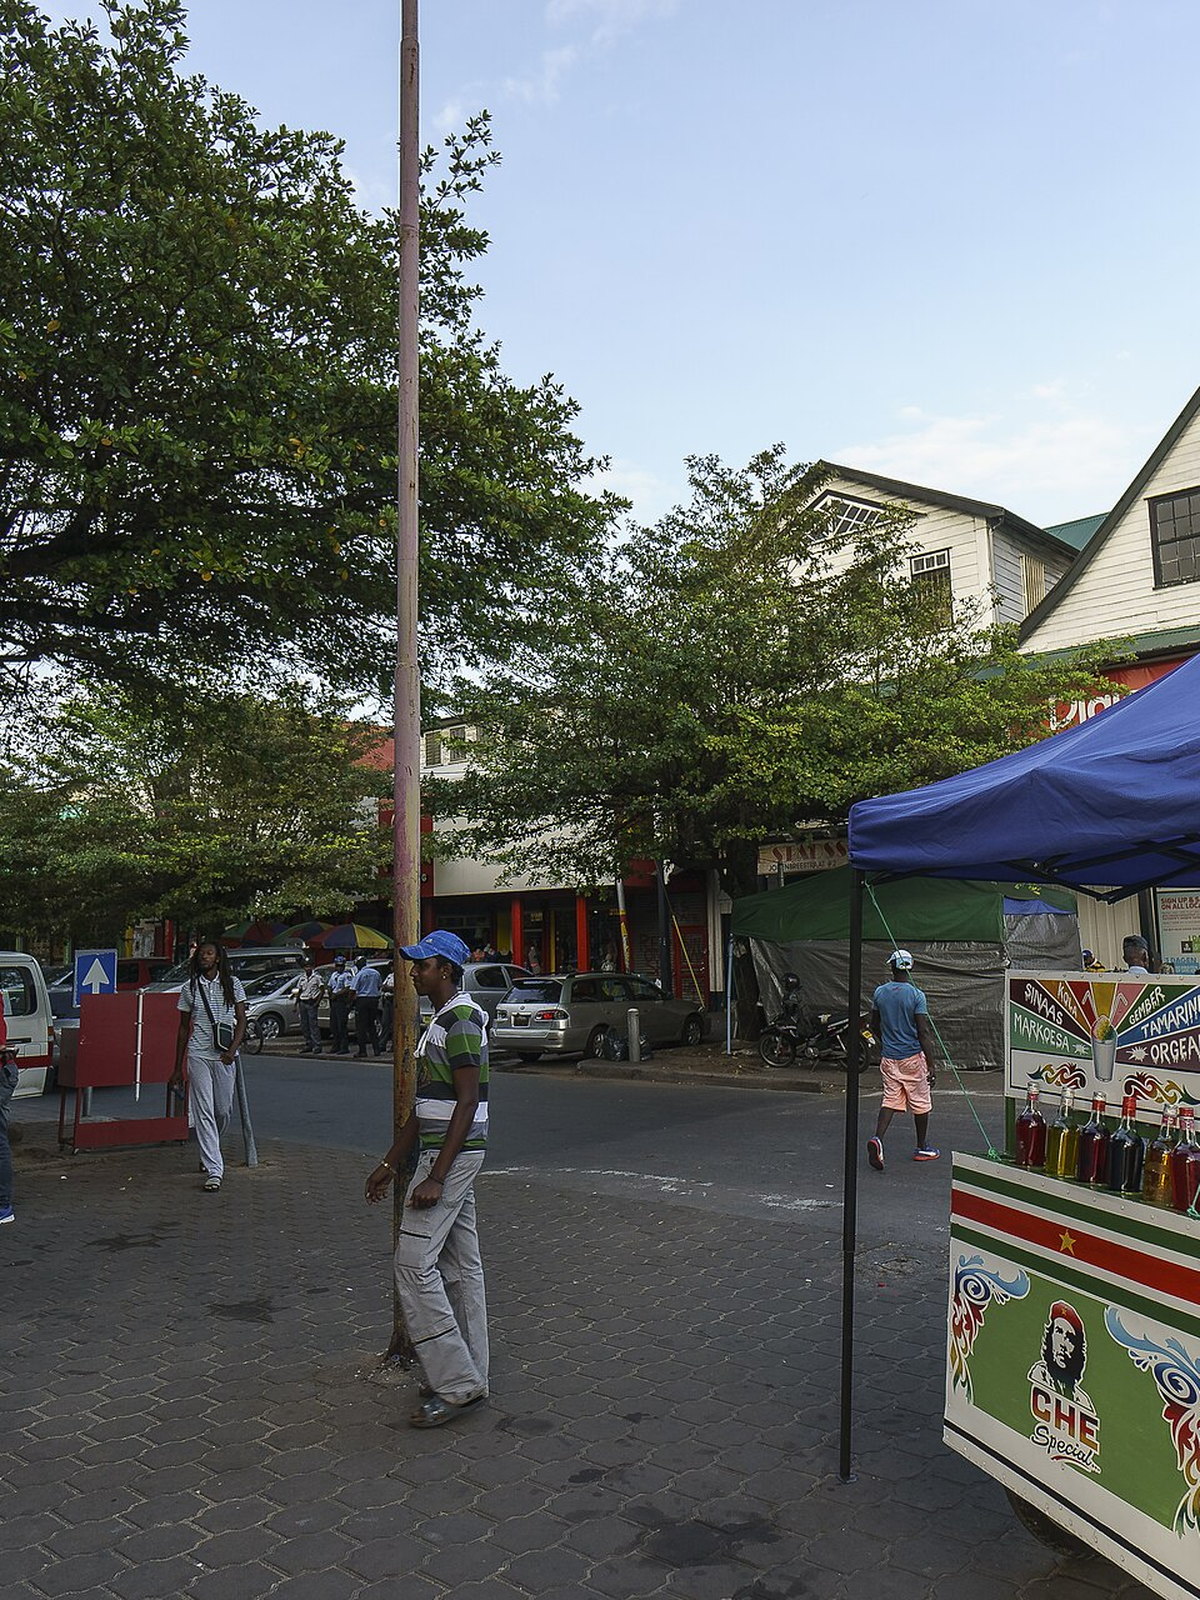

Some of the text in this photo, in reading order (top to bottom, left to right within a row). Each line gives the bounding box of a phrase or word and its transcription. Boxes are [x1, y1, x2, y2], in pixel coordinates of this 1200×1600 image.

[1160, 896, 1177, 904] SIGN
[1178, 896, 1187, 904] UP
[1024, 983, 1064, 1025] SINAAS
[1057, 982, 1078, 1019] KOLA
[1129, 986, 1166, 1025] GEMBER
[1013, 1013, 1070, 1052] MARKOESA
[1150, 1034, 1200, 1065] ORGEA
[1031, 1386, 1099, 1452] CHE
